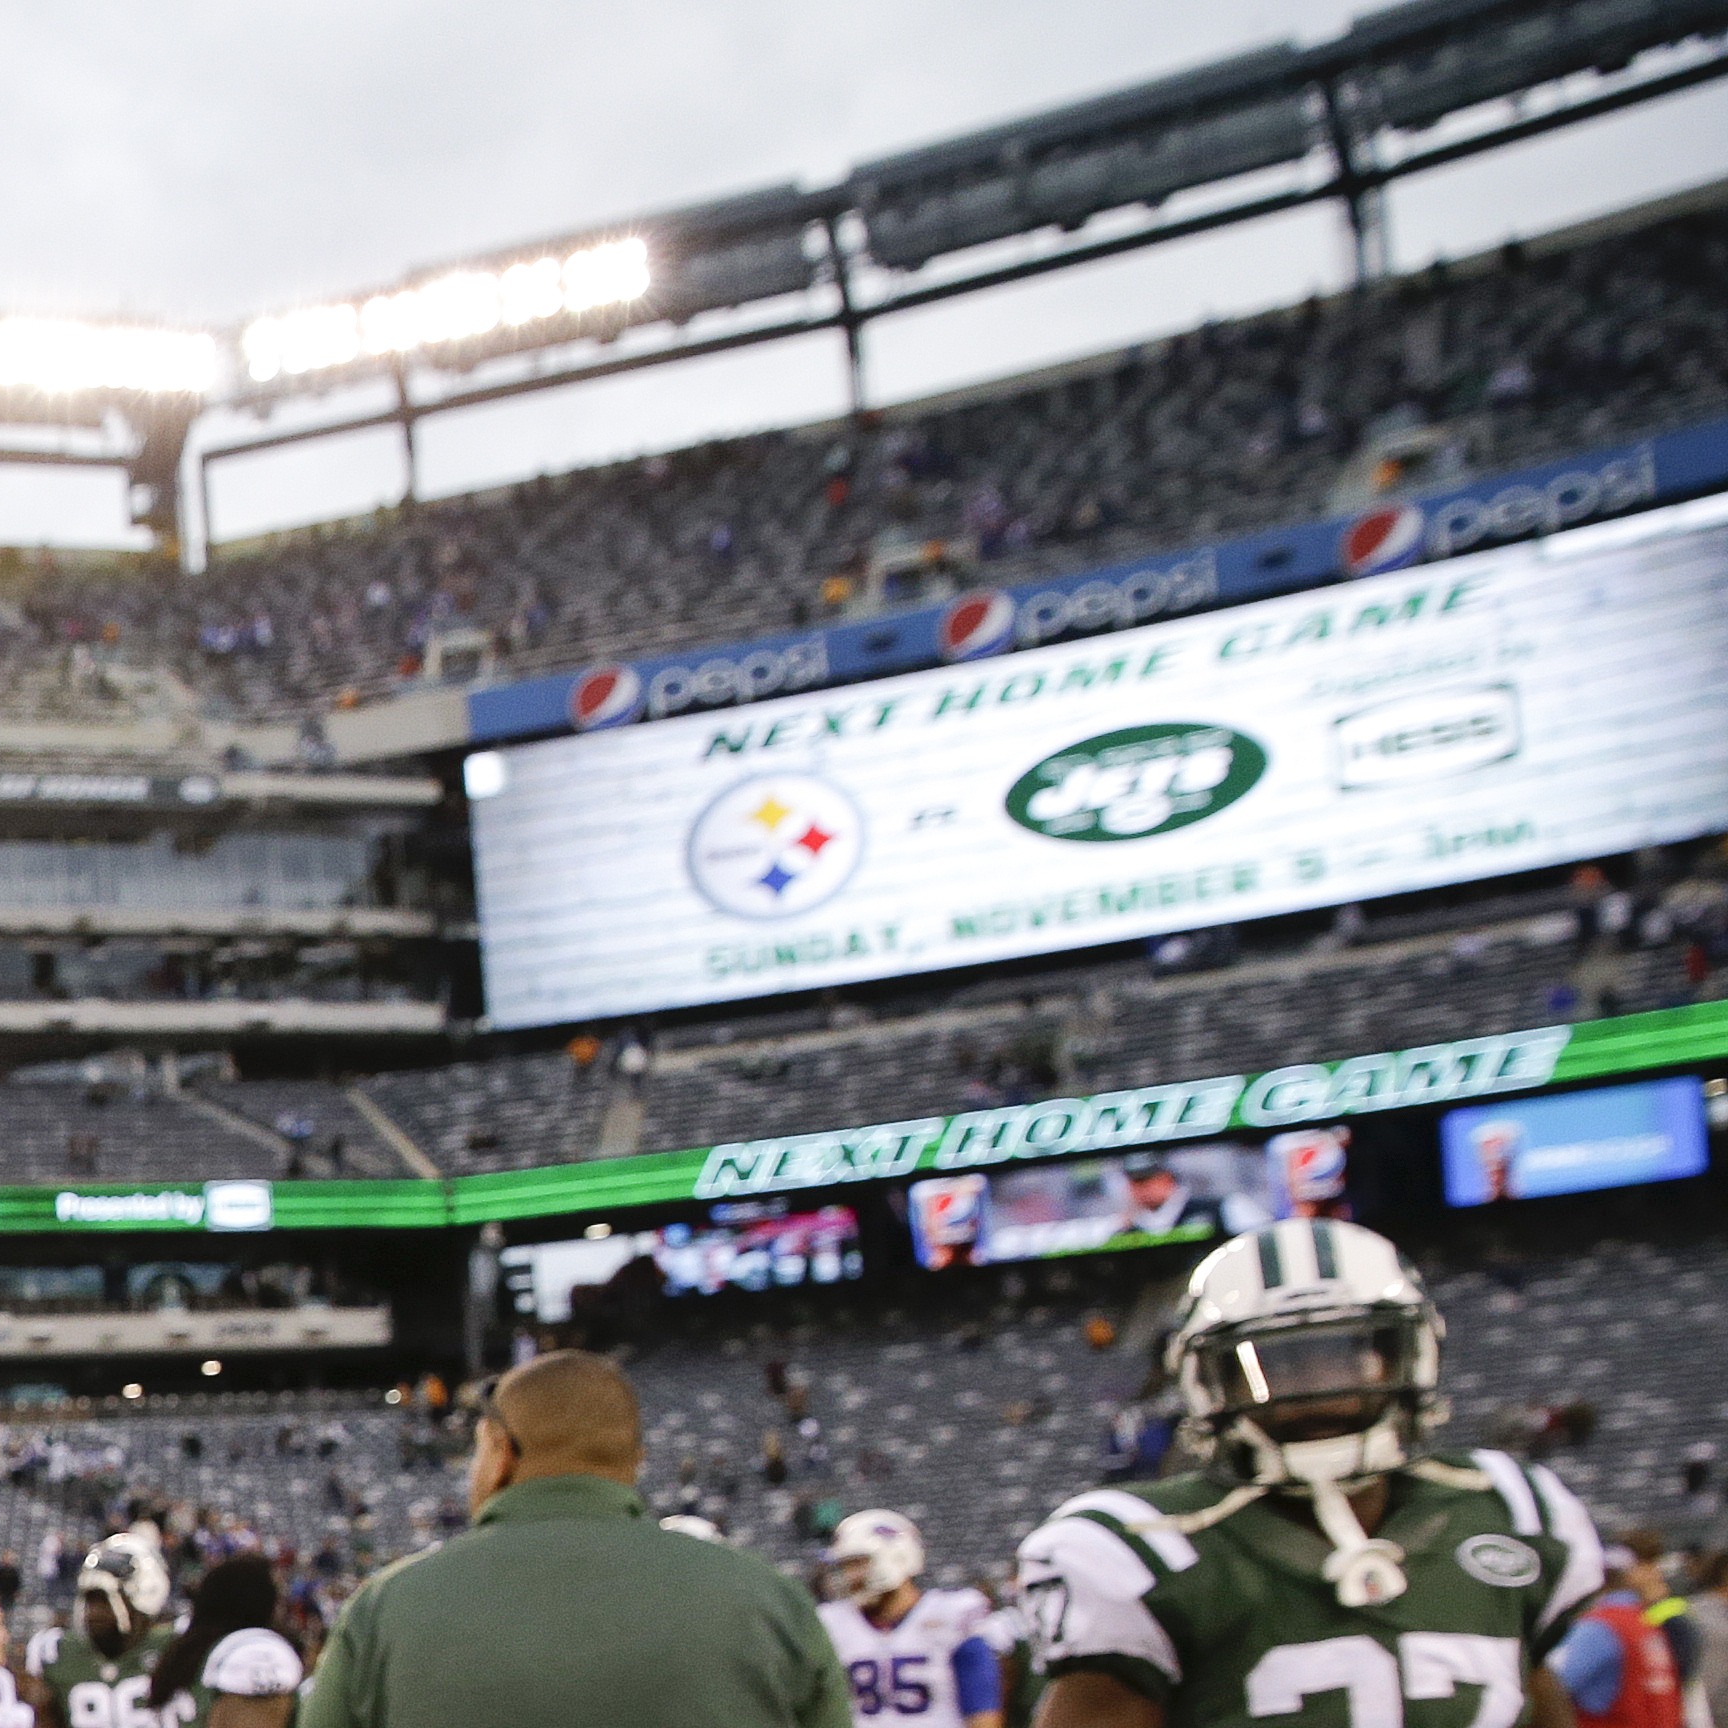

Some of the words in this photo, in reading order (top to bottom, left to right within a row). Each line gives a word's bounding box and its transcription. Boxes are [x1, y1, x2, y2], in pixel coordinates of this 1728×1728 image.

[1425, 438, 1656, 556] pepsi
[1015, 546, 1220, 649] pepsi
[647, 630, 831, 722] pepsi
[701, 700, 901, 764] NEXT
[931, 636, 1196, 722] HOME
[1217, 567, 1502, 663] GAME
[949, 858, 1262, 942] NOVEMBER
[692, 1115, 946, 1200] NEXT
[934, 1074, 1245, 1170] HOME
[1241, 1024, 1574, 1127] GAME
